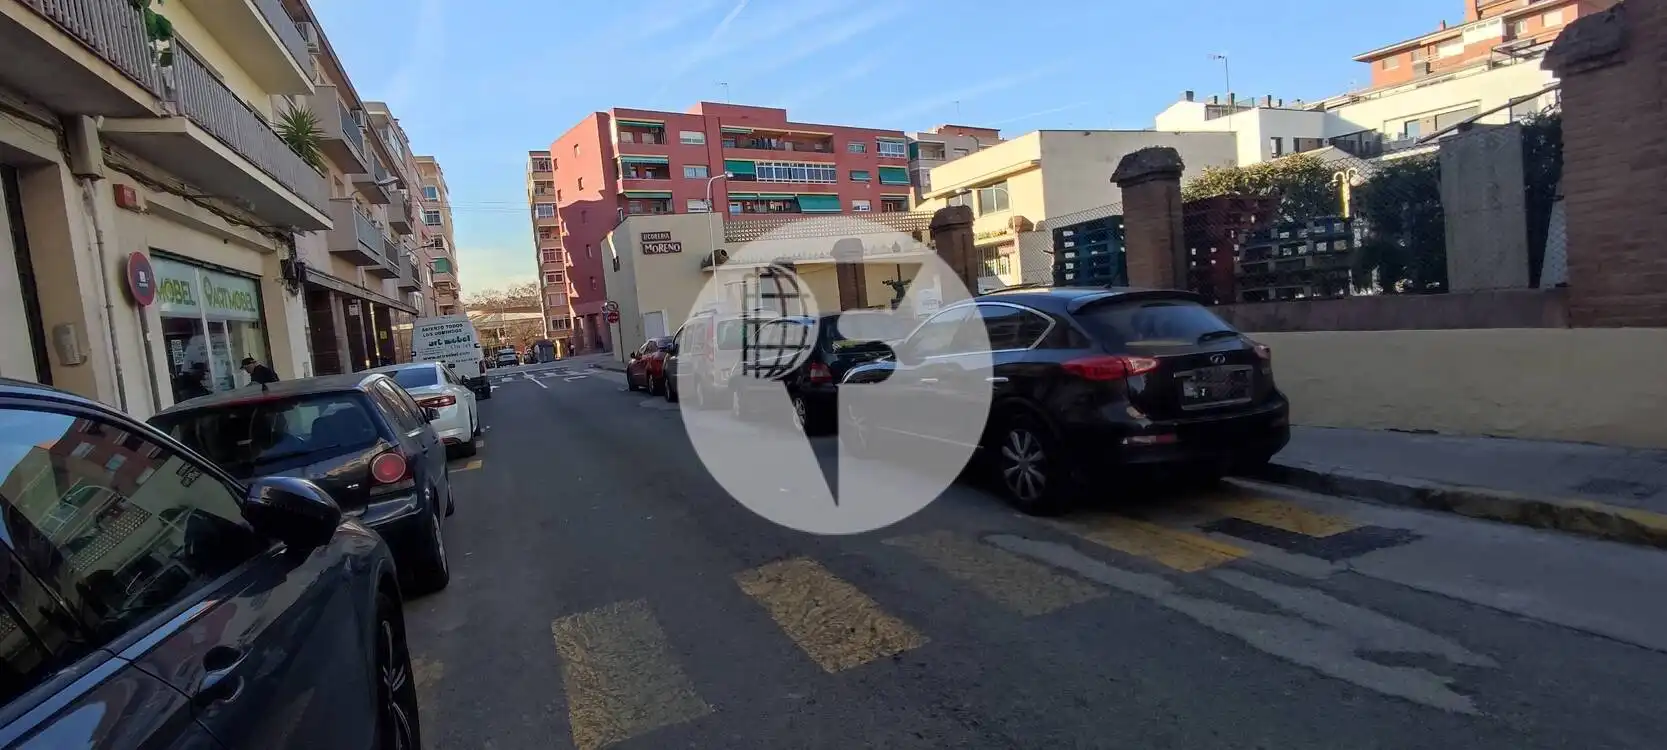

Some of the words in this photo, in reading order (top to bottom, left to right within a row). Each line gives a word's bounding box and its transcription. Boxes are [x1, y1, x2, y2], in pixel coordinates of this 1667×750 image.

[644, 243, 680, 253] MORENO
[434, 328, 462, 336] DOMINGOS
[428, 338, 443, 347] art
